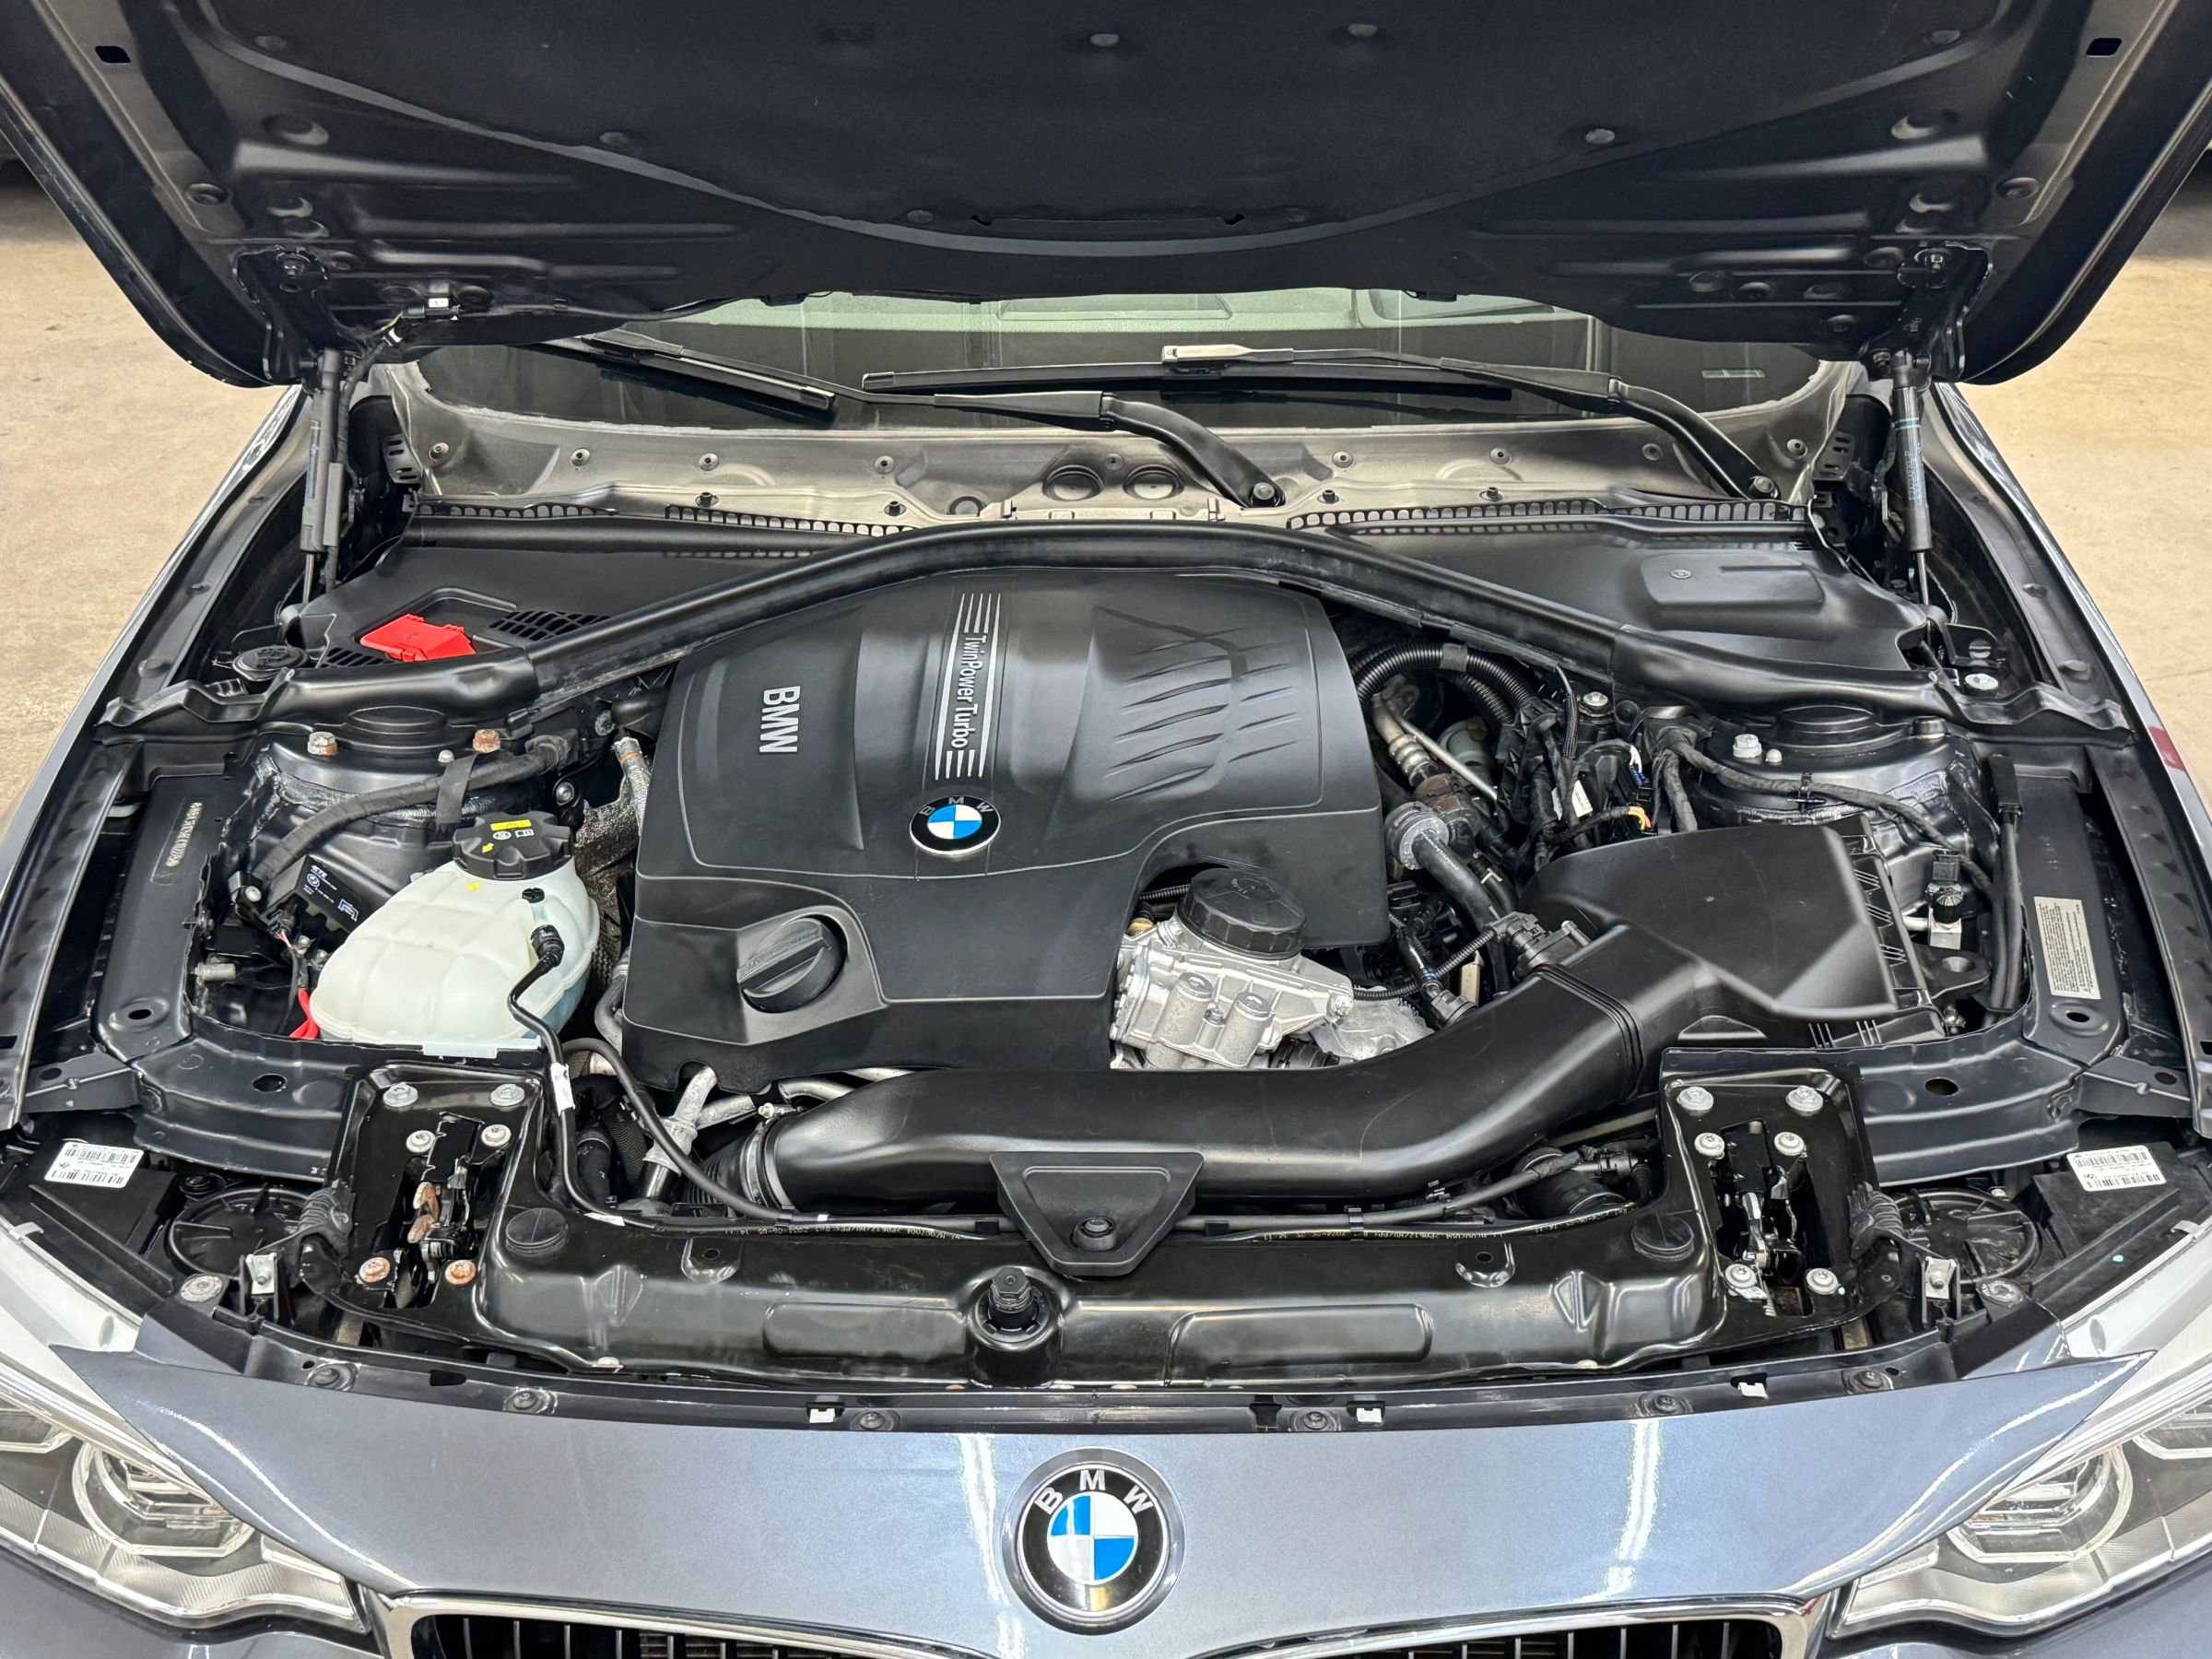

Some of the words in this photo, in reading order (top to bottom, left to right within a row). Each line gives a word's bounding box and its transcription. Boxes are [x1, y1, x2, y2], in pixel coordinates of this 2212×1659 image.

[957, 635, 987, 702] TwinPower
[759, 686, 801, 753] BMW
[950, 703, 978, 748] Turbo
[919, 796, 994, 817] BMW
[1034, 1469, 1154, 1515] BMW
